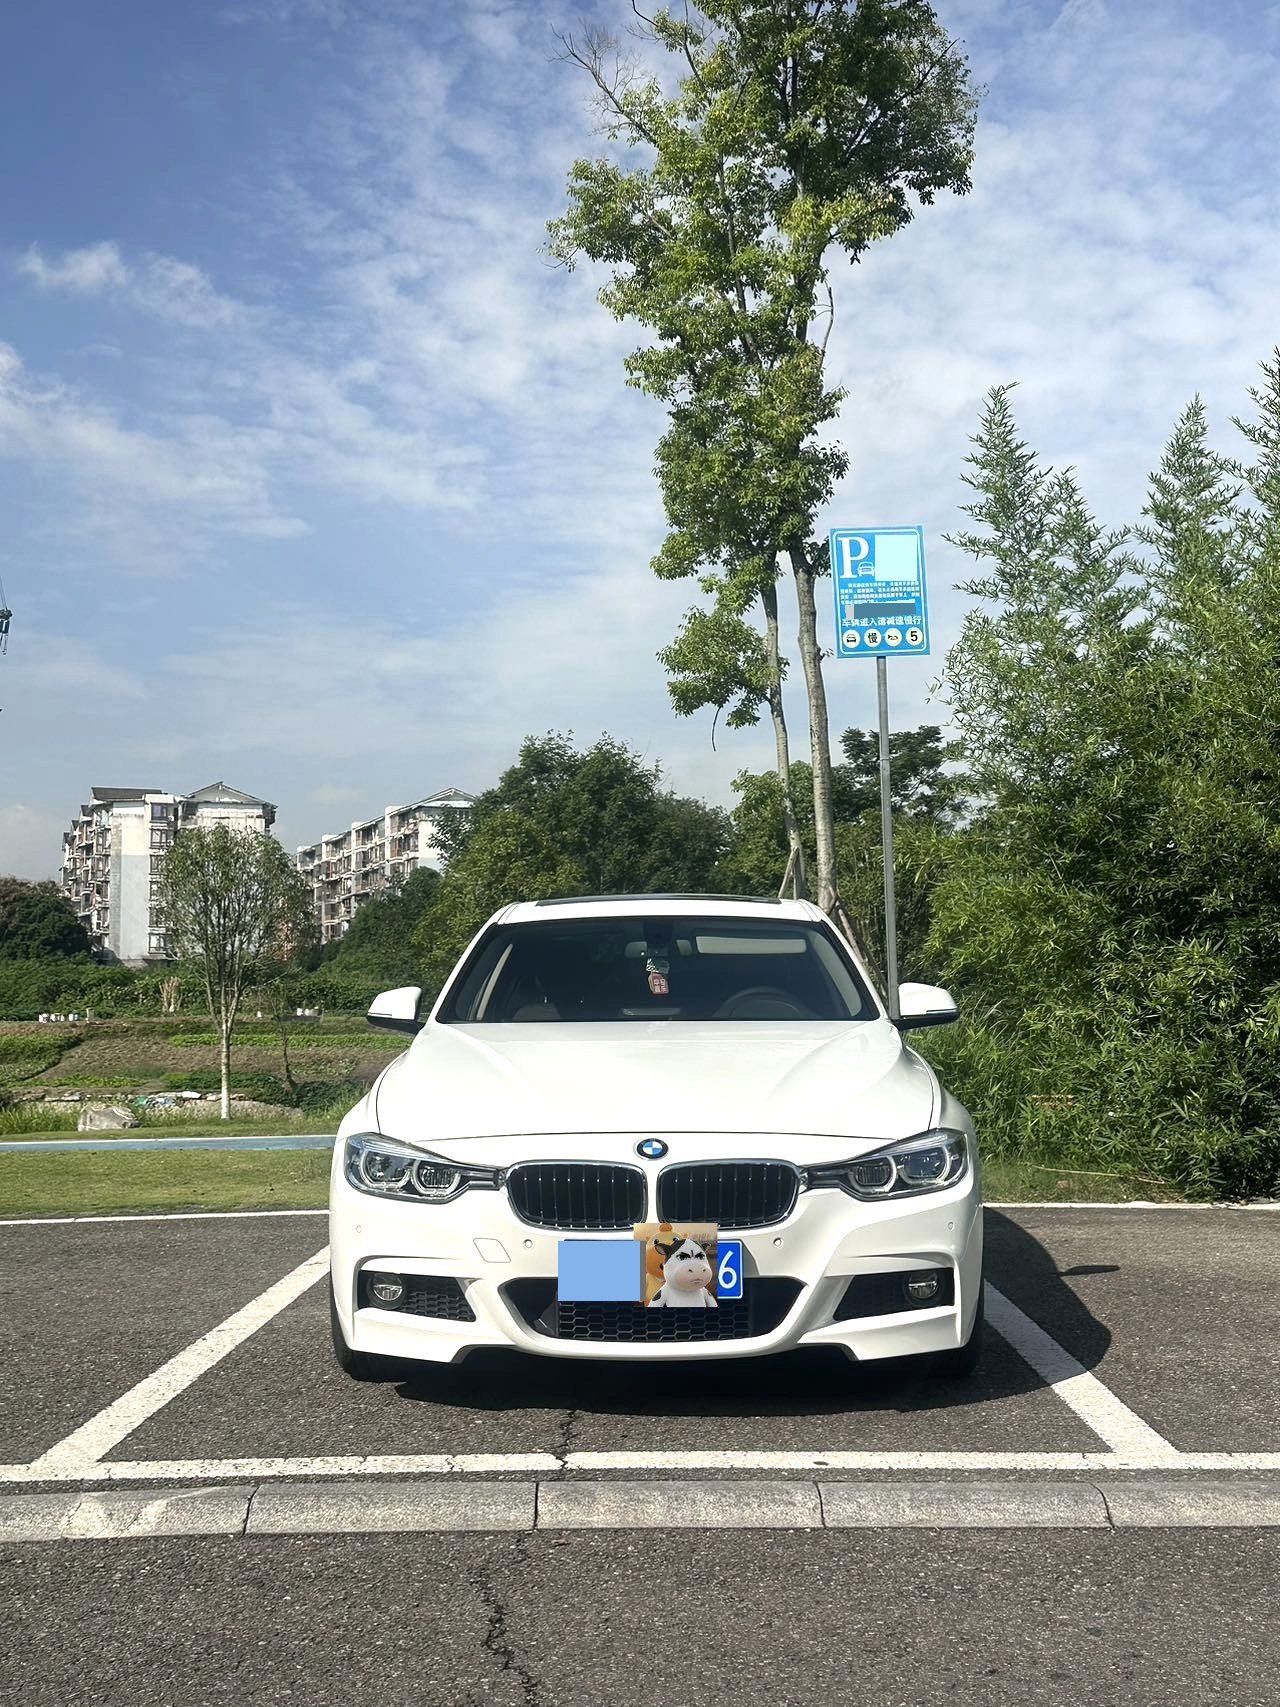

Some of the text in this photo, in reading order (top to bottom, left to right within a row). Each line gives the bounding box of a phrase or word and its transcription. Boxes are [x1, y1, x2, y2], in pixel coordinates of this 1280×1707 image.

[837, 536, 870, 579] P
[867, 632, 878, 644] 慢
[910, 630, 918, 642] 5
[718, 1249, 738, 1289] 6
